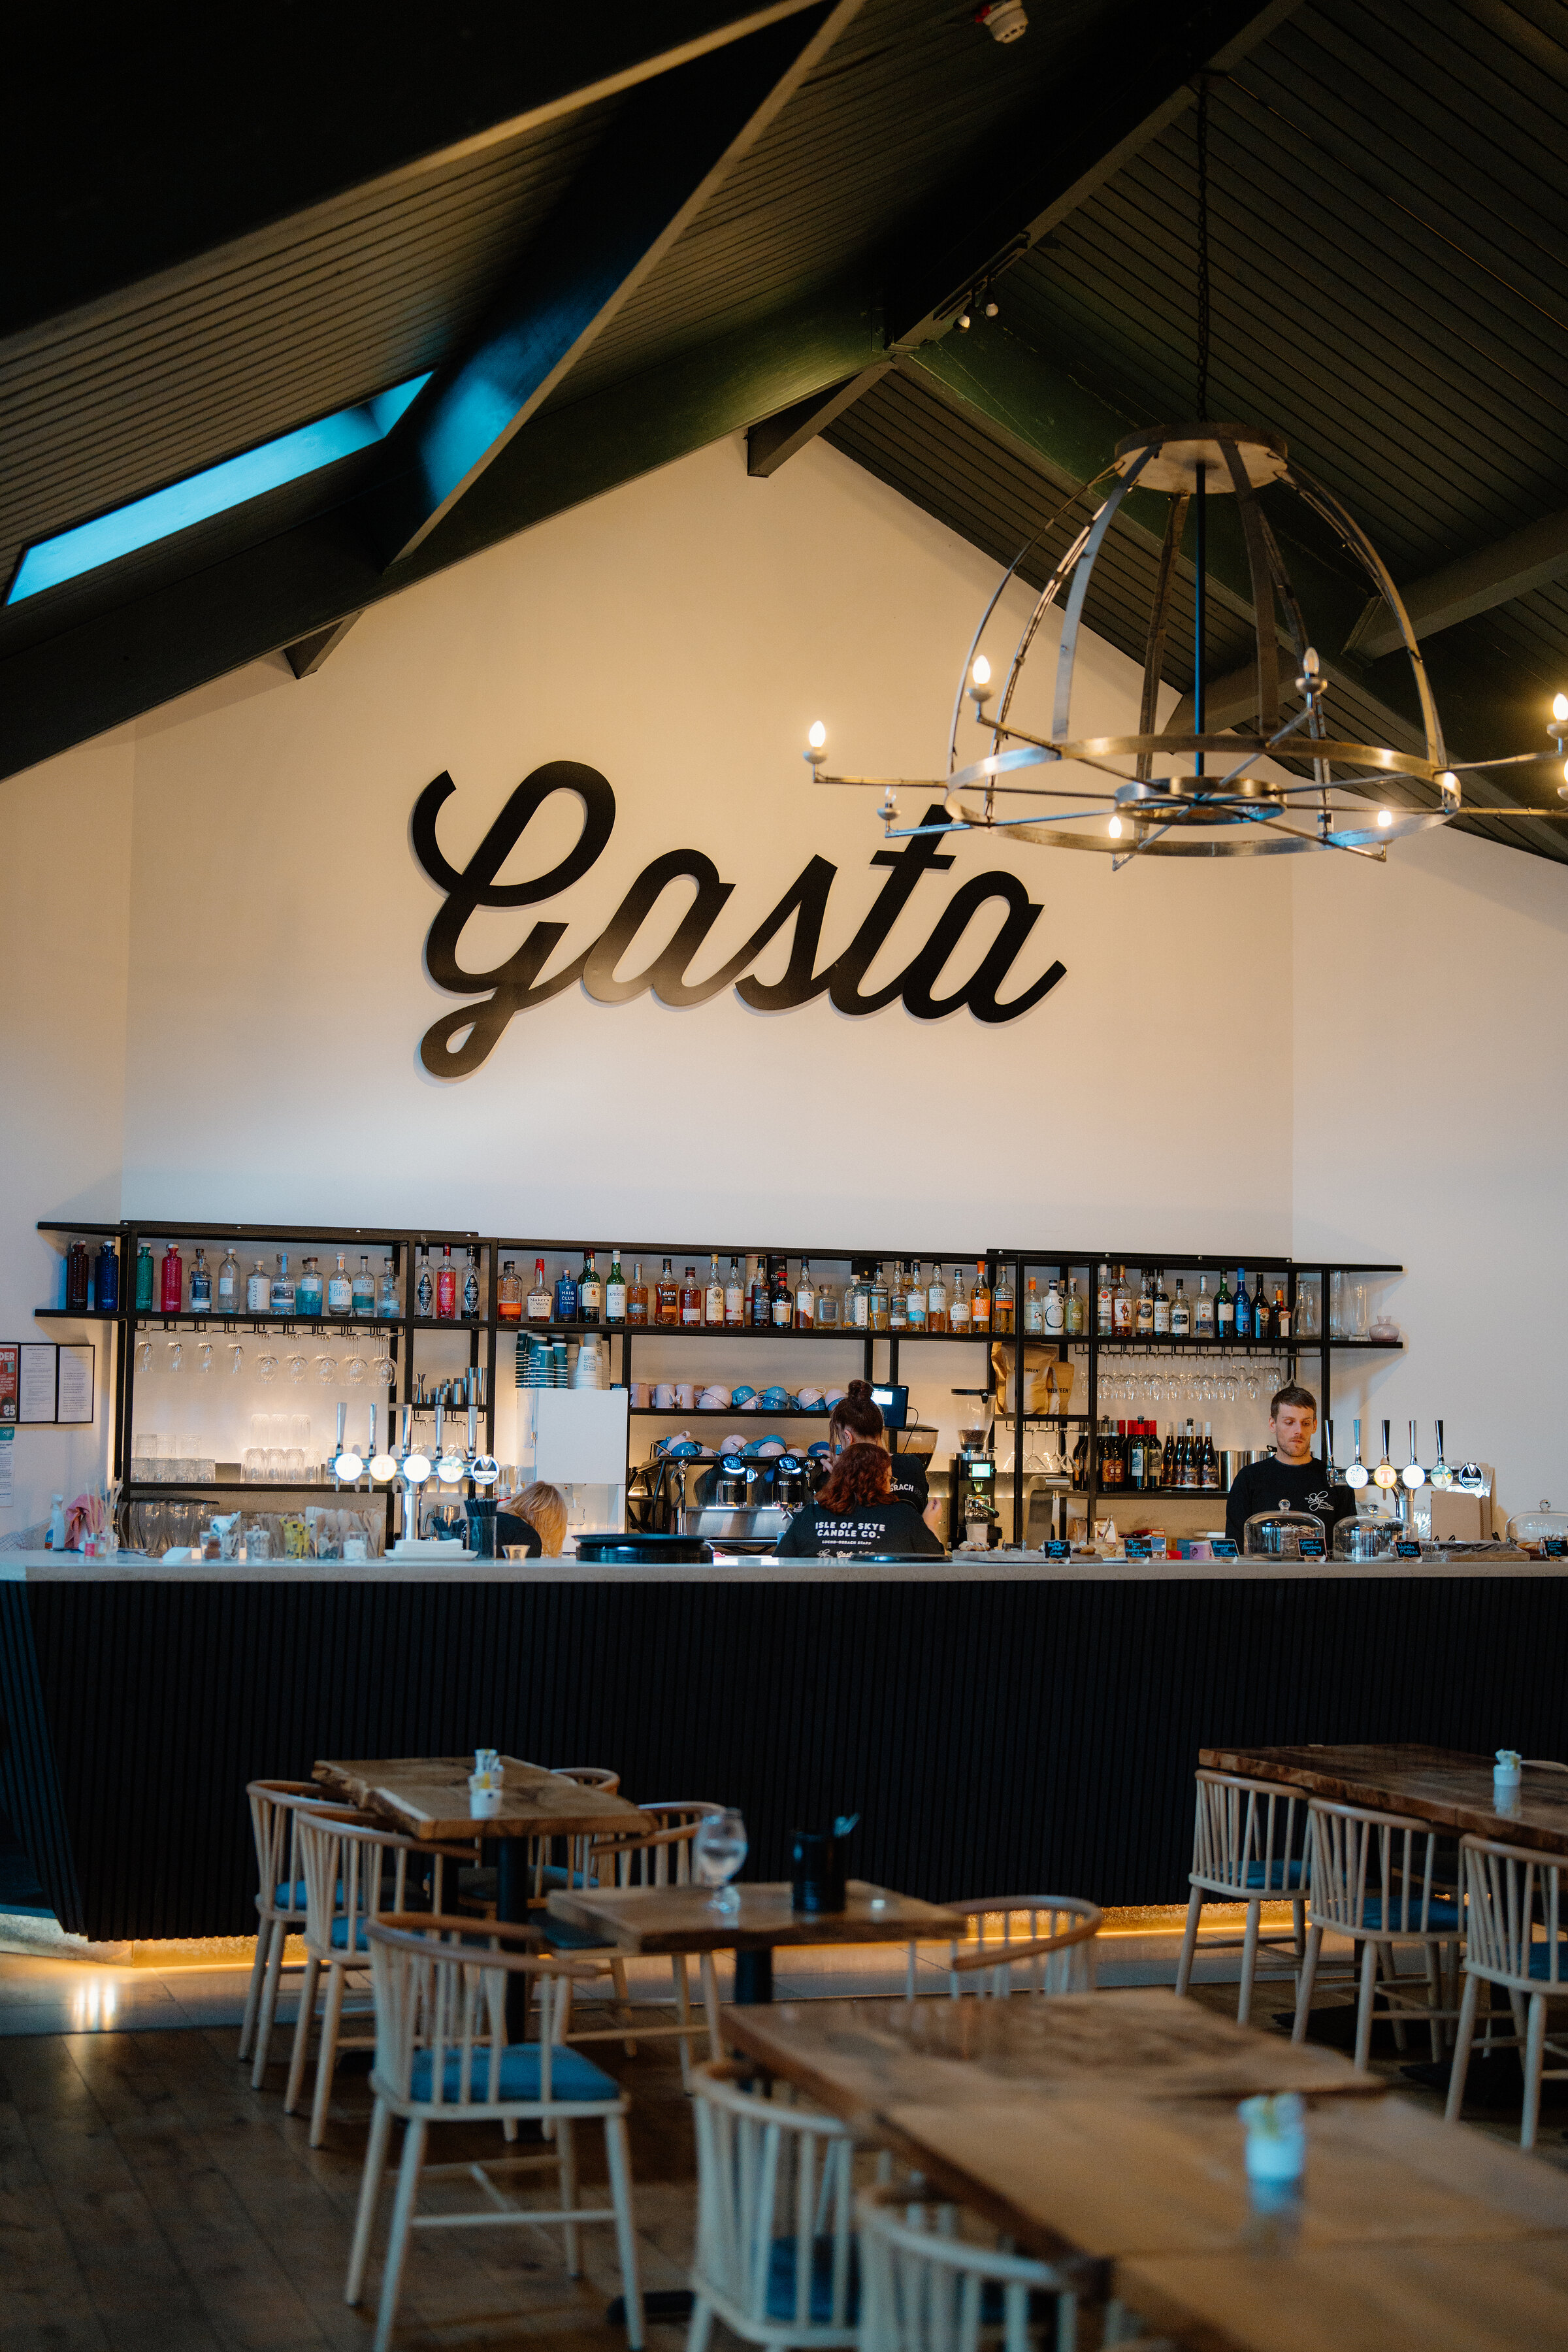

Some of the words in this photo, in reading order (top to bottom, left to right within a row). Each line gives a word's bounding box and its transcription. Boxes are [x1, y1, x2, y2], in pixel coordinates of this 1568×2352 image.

[412, 760, 1068, 1078] Gasta
[3, 1405, 15, 1416] 25
[378, 1462, 388, 1475] T
[1380, 1471, 1391, 1483] T
[1308, 1491, 1328, 1511] Skye
[858, 1522, 886, 1532] SKYE
[861, 1530, 881, 1539] CO.
